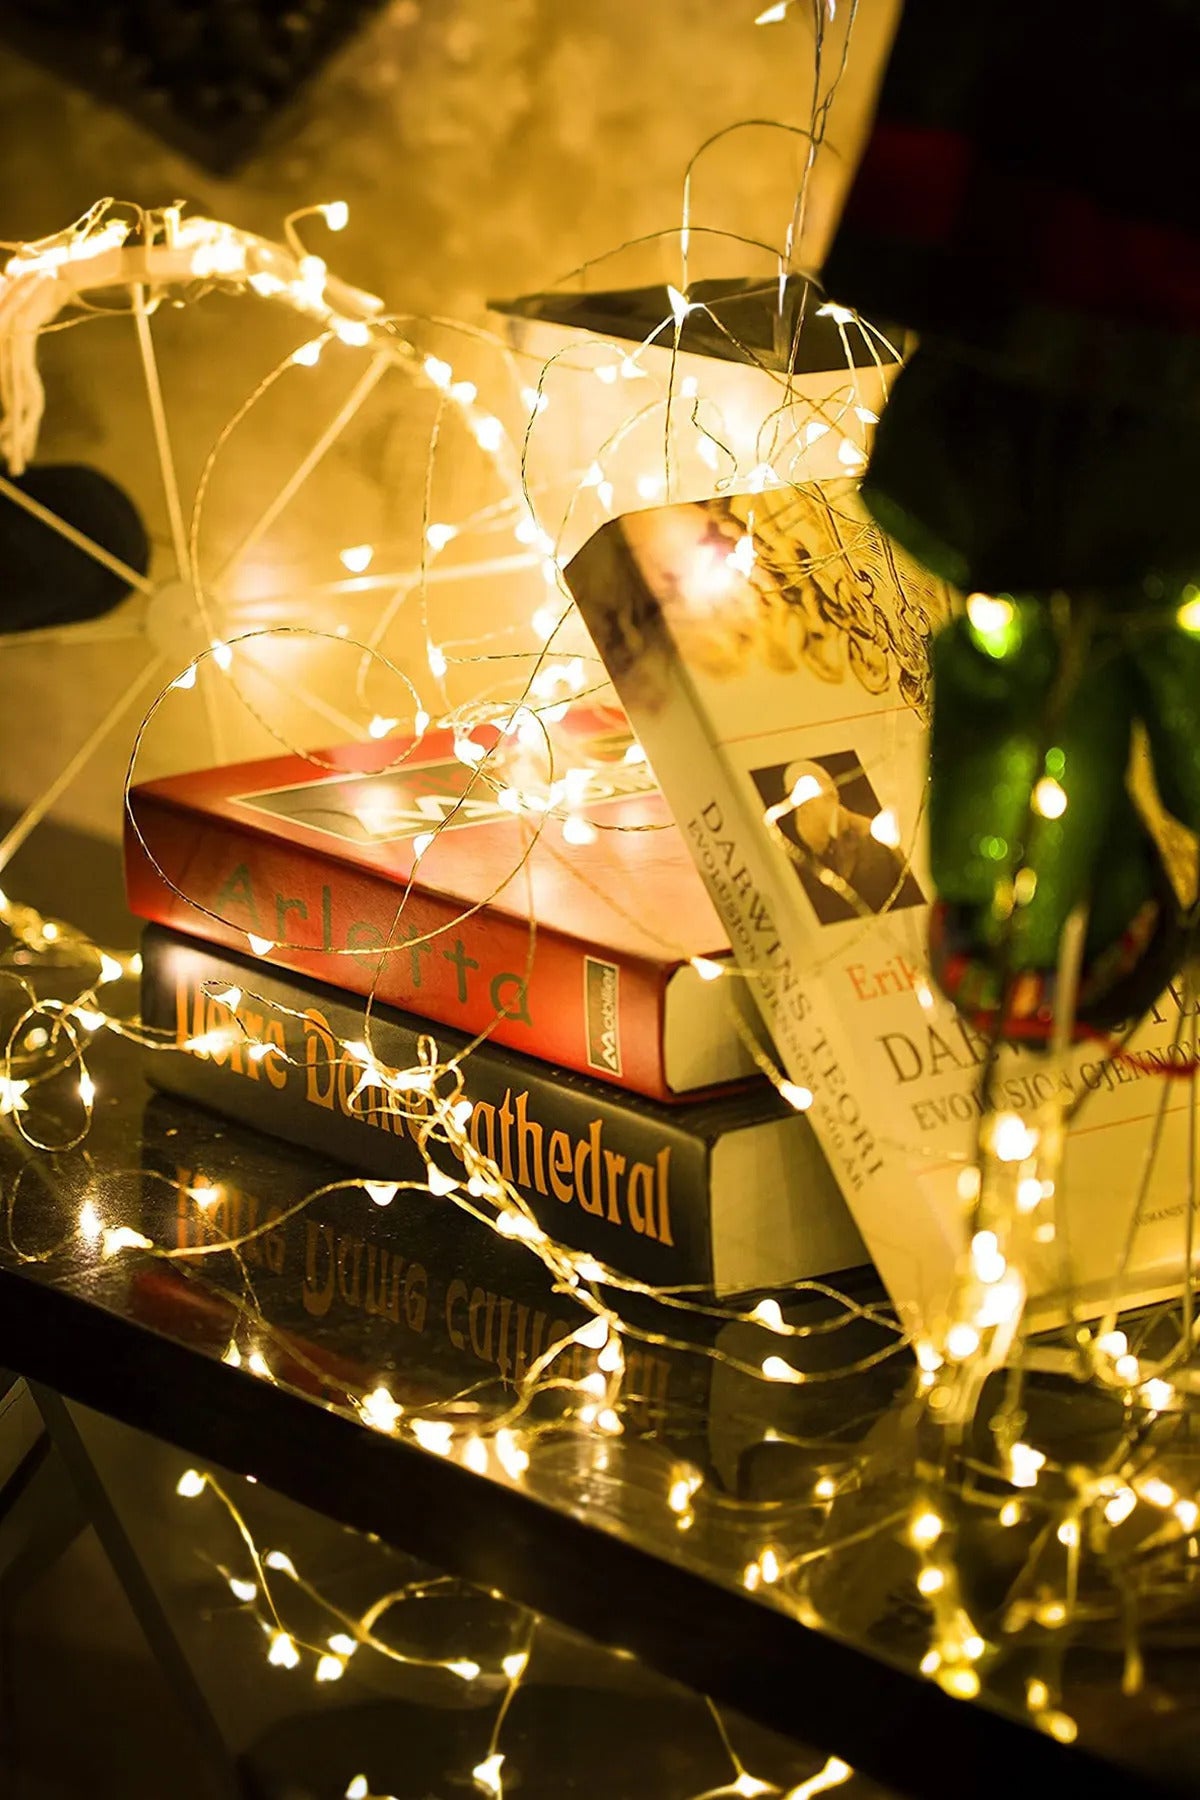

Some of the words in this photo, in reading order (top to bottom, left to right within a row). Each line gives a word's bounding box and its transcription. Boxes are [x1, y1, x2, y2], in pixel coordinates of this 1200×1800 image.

[214, 862, 533, 1027] Arletta
[700, 800, 813, 1022] DARWINS
[809, 1028, 886, 1178] TEORI
